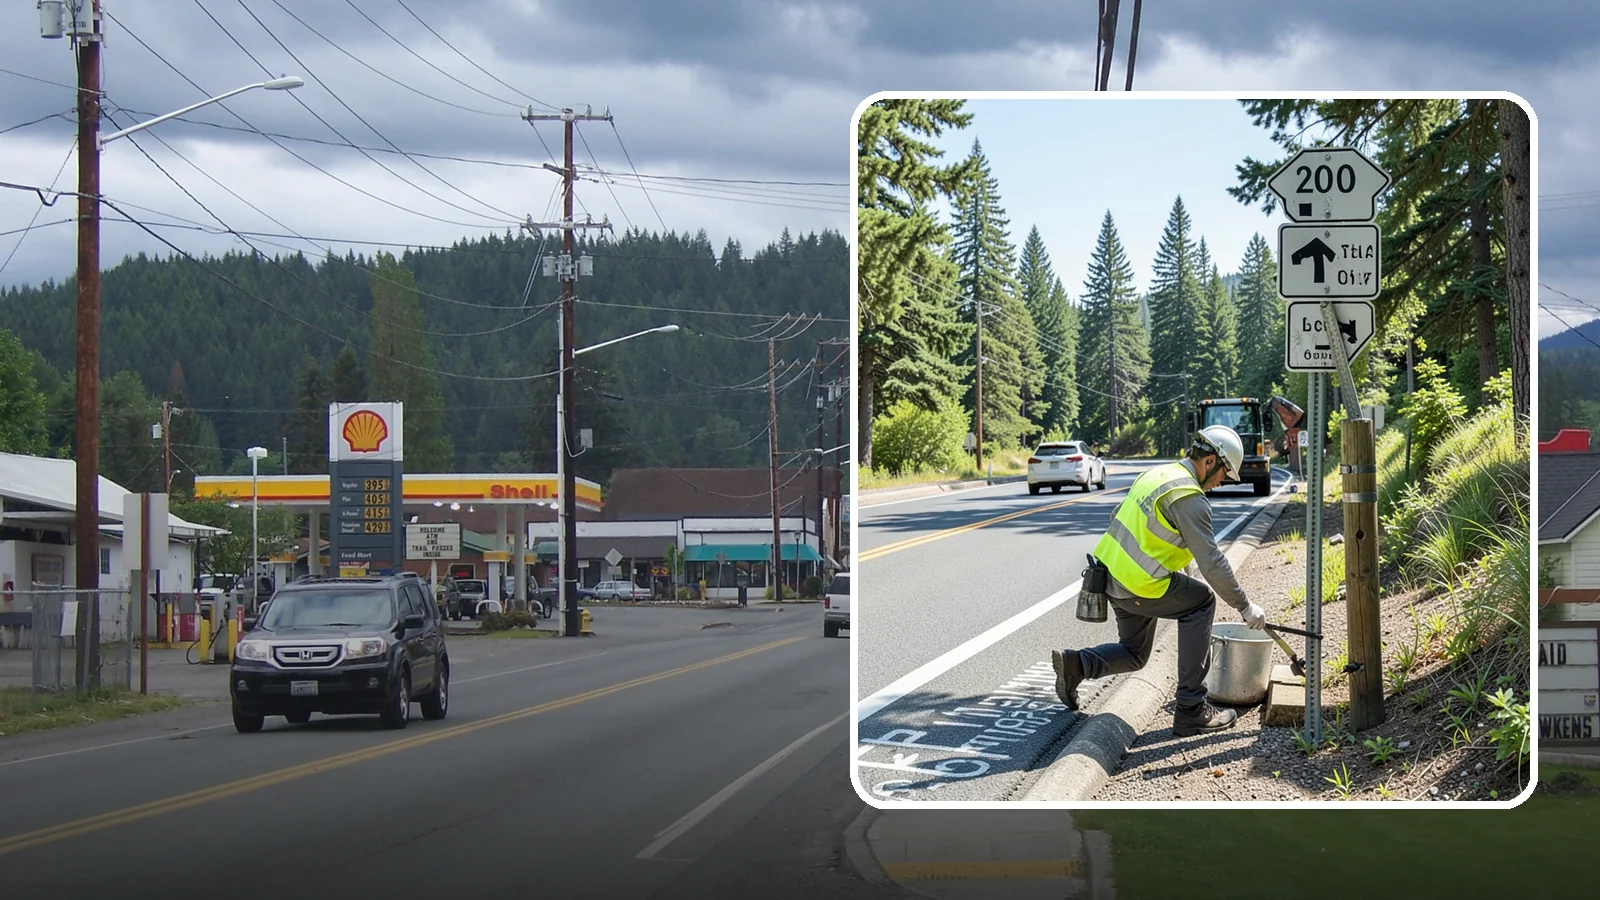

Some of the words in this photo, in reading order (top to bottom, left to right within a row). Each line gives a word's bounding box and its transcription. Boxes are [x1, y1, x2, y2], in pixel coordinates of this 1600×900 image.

[1296, 164, 1356, 194] 200
[366, 480, 383, 490] 395
[490, 484, 547, 498] Shell
[365, 494, 383, 504] 405
[365, 508, 383, 517] 415
[366, 522, 383, 532] 429
